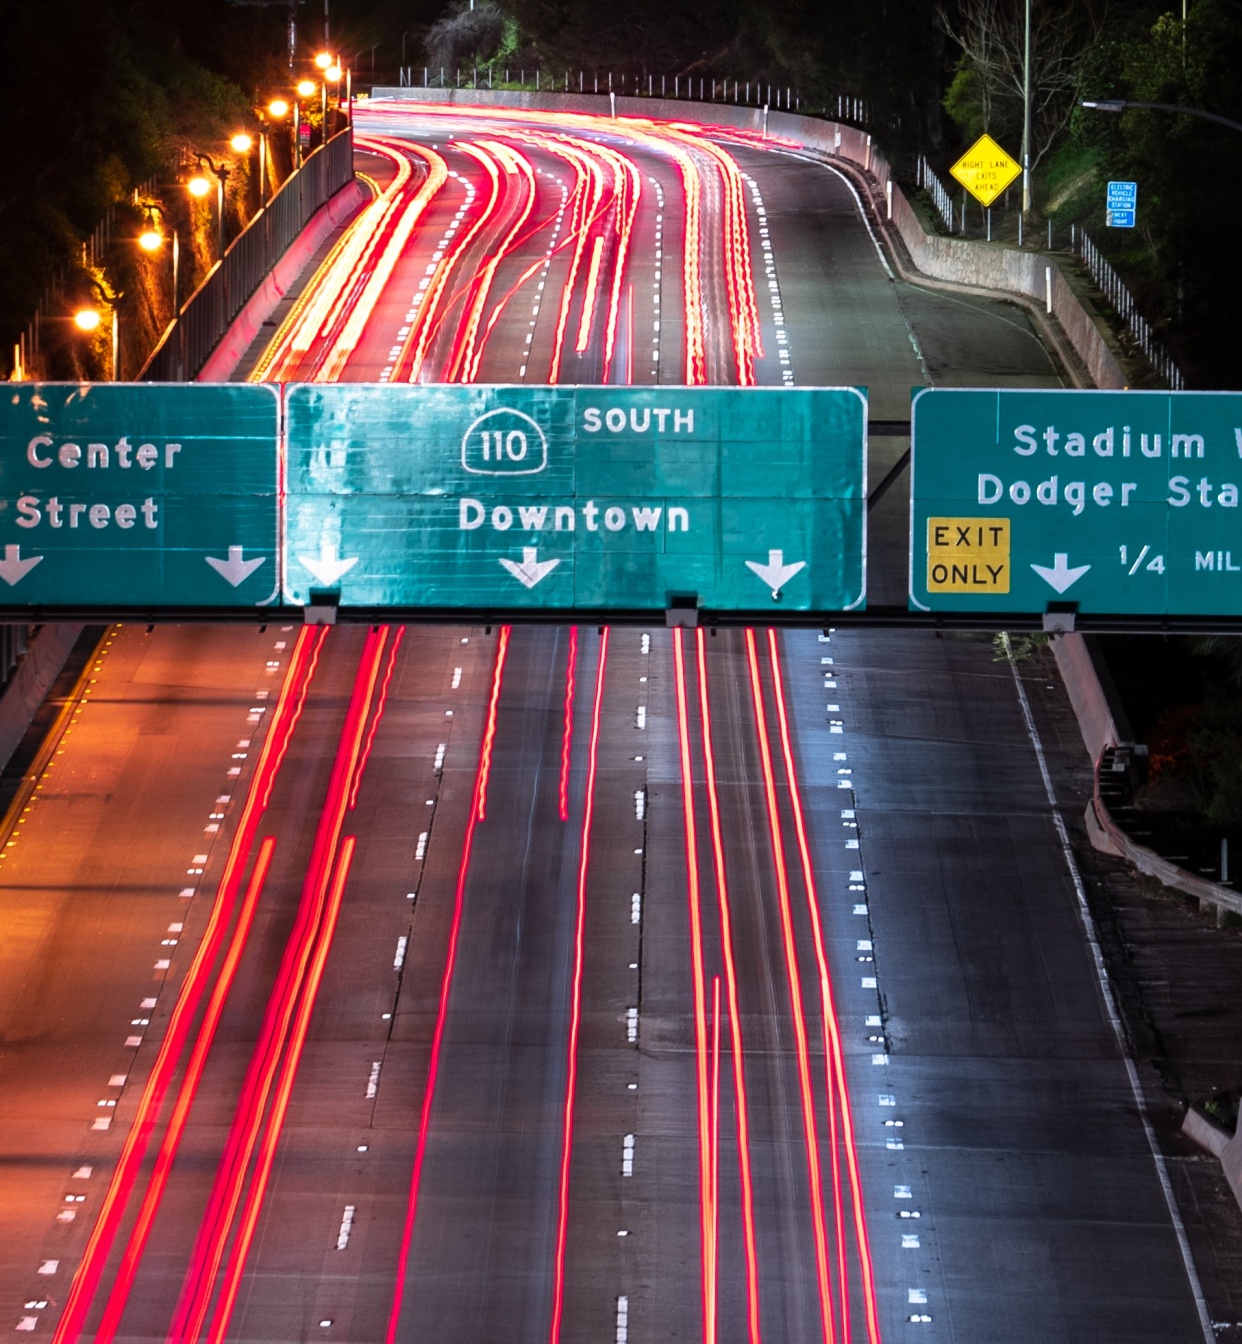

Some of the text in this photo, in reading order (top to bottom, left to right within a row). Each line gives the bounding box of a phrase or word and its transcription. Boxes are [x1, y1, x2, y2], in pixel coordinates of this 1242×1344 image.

[962, 160, 1009, 168] RIGHT LANE
[976, 172, 997, 180] EXITS
[975, 183, 999, 191] AHEAD
[481, 407, 694, 461] 110 SOUTH
[1013, 424, 1205, 458] Stadium
[27, 436, 182, 469] Center
[977, 473, 1239, 516] Dodger Sta
[15, 495, 159, 529] Street
[459, 498, 690, 531] Downtown
[935, 526, 1003, 547] EXIT
[1195, 550, 1241, 571] MIL
[932, 564, 1004, 585] ONLY
